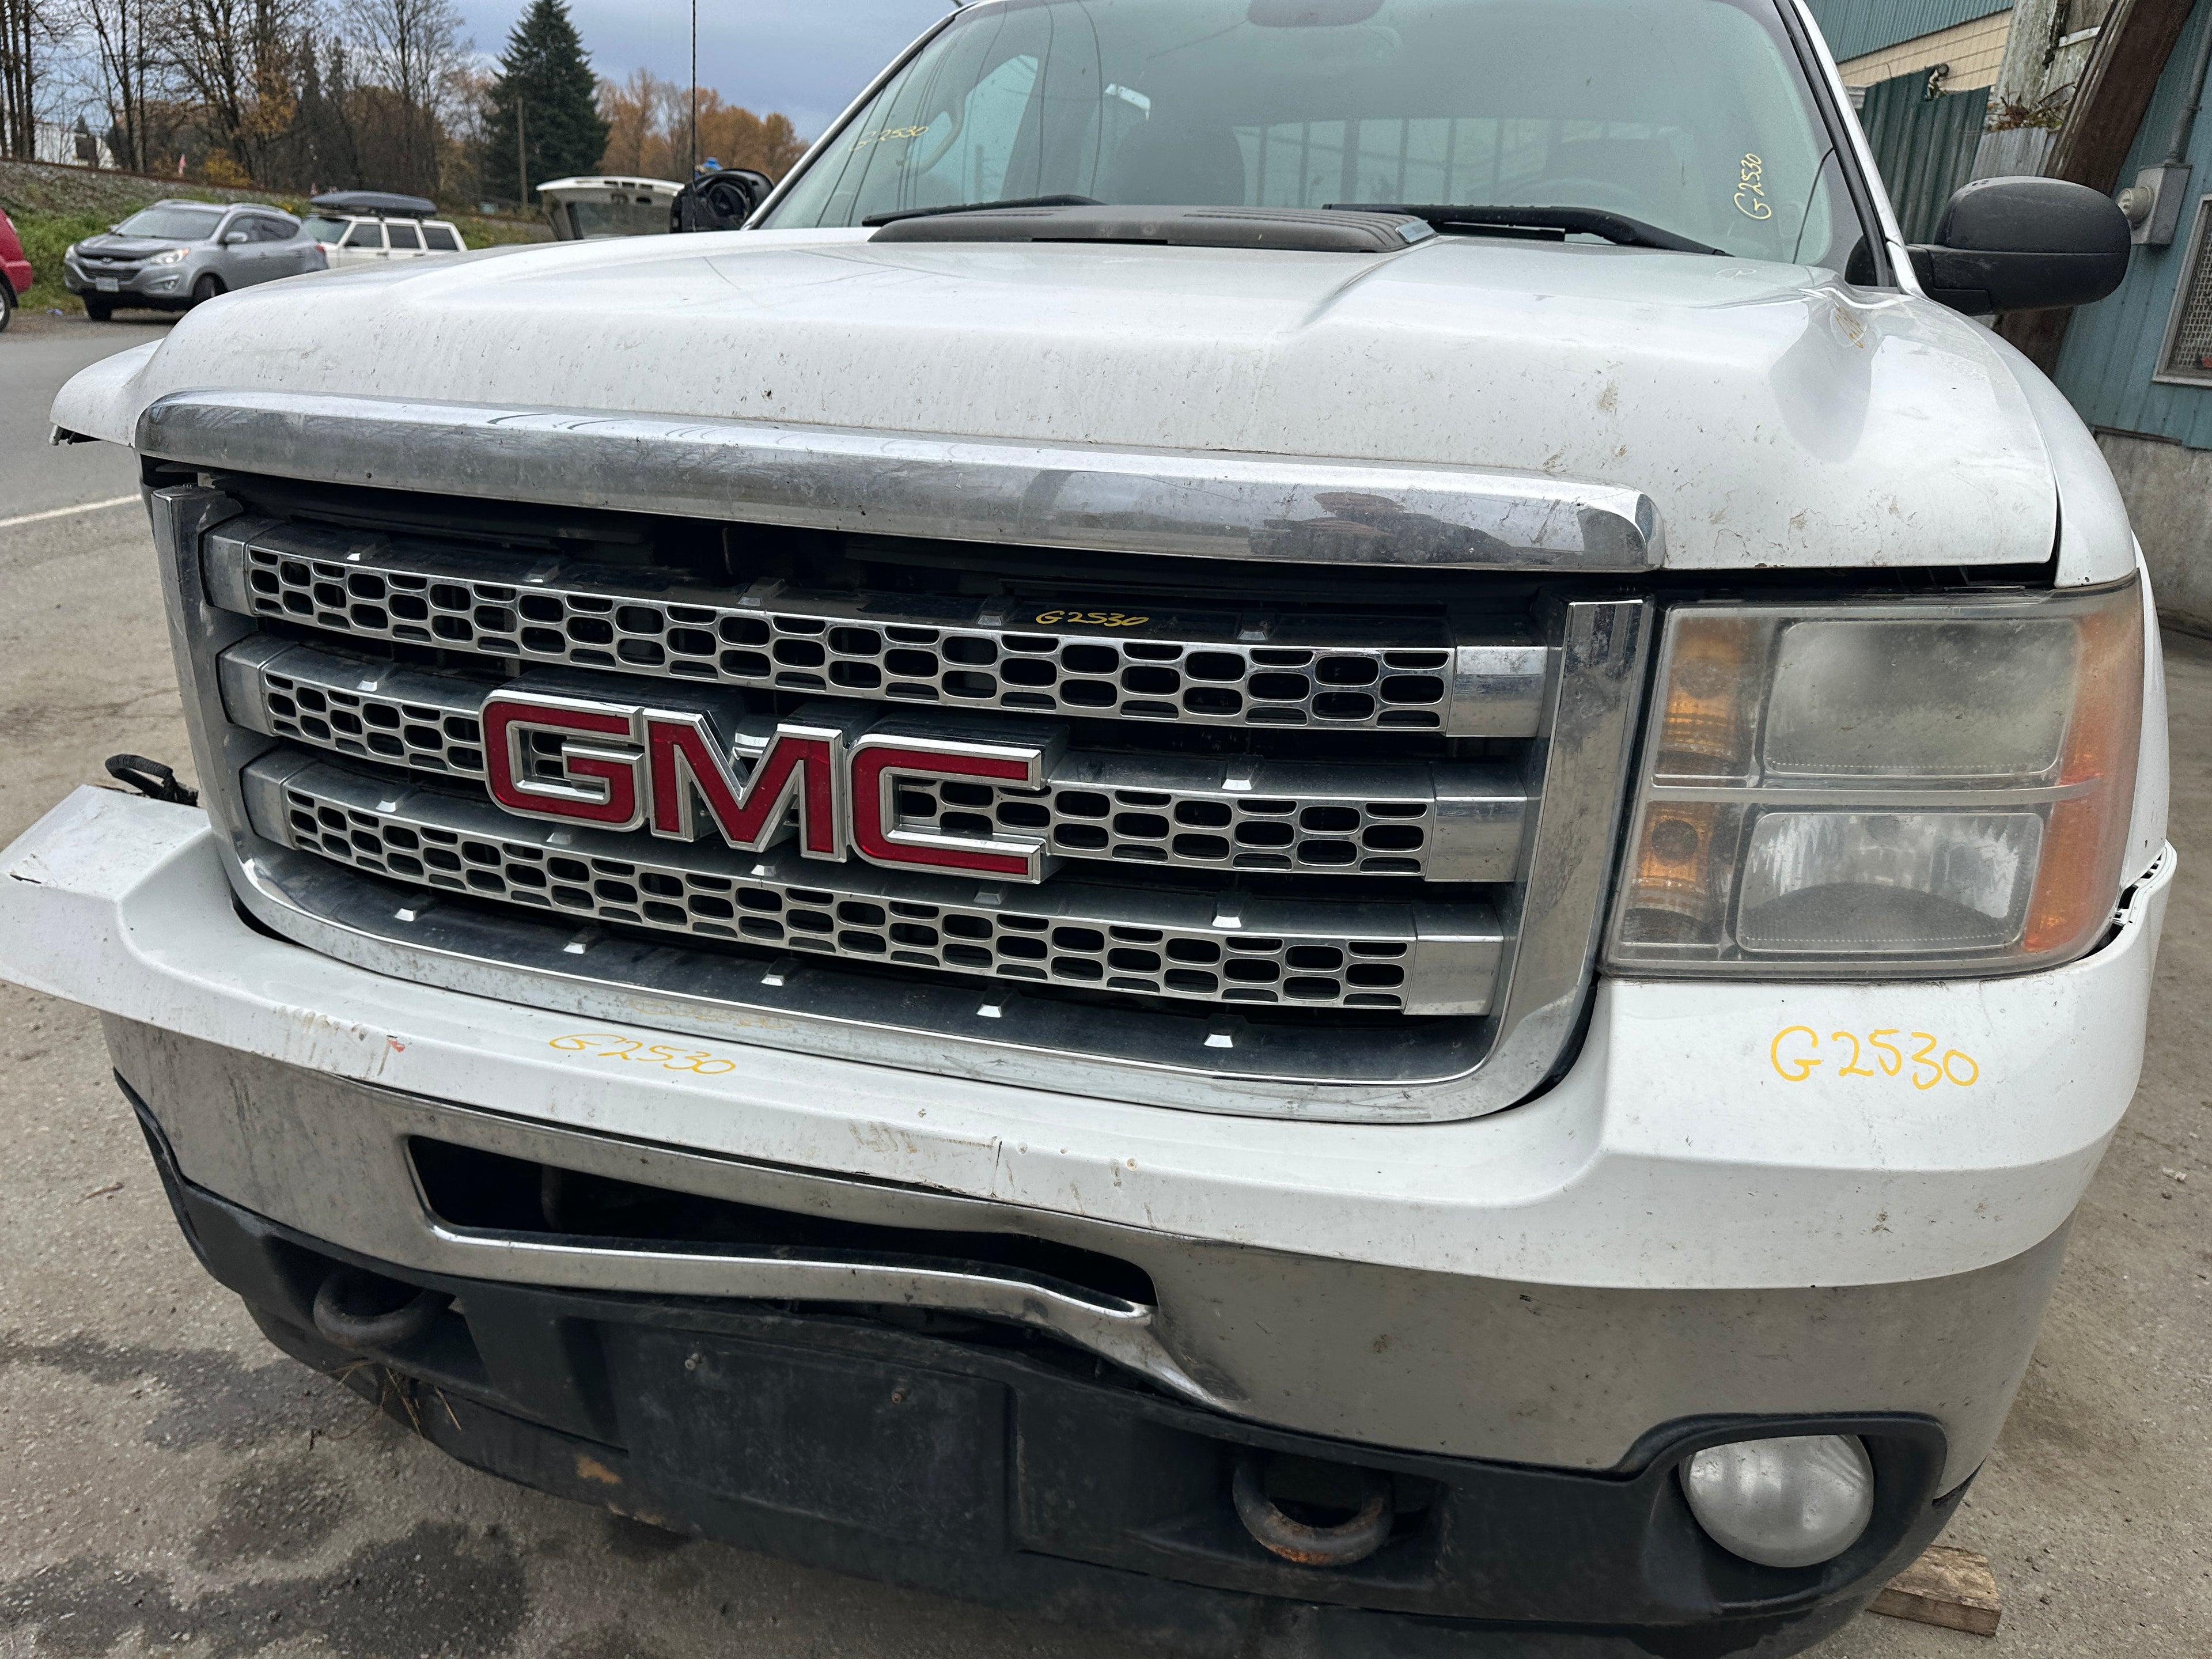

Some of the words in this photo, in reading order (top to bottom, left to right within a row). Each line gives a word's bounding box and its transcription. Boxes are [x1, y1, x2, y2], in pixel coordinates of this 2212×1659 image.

[1733, 153, 1772, 219] G2530
[1036, 610, 1150, 627] G2530
[479, 690, 1041, 884] GMC
[549, 1033, 736, 1074] G2530
[1770, 1025, 1979, 1090] G2530
